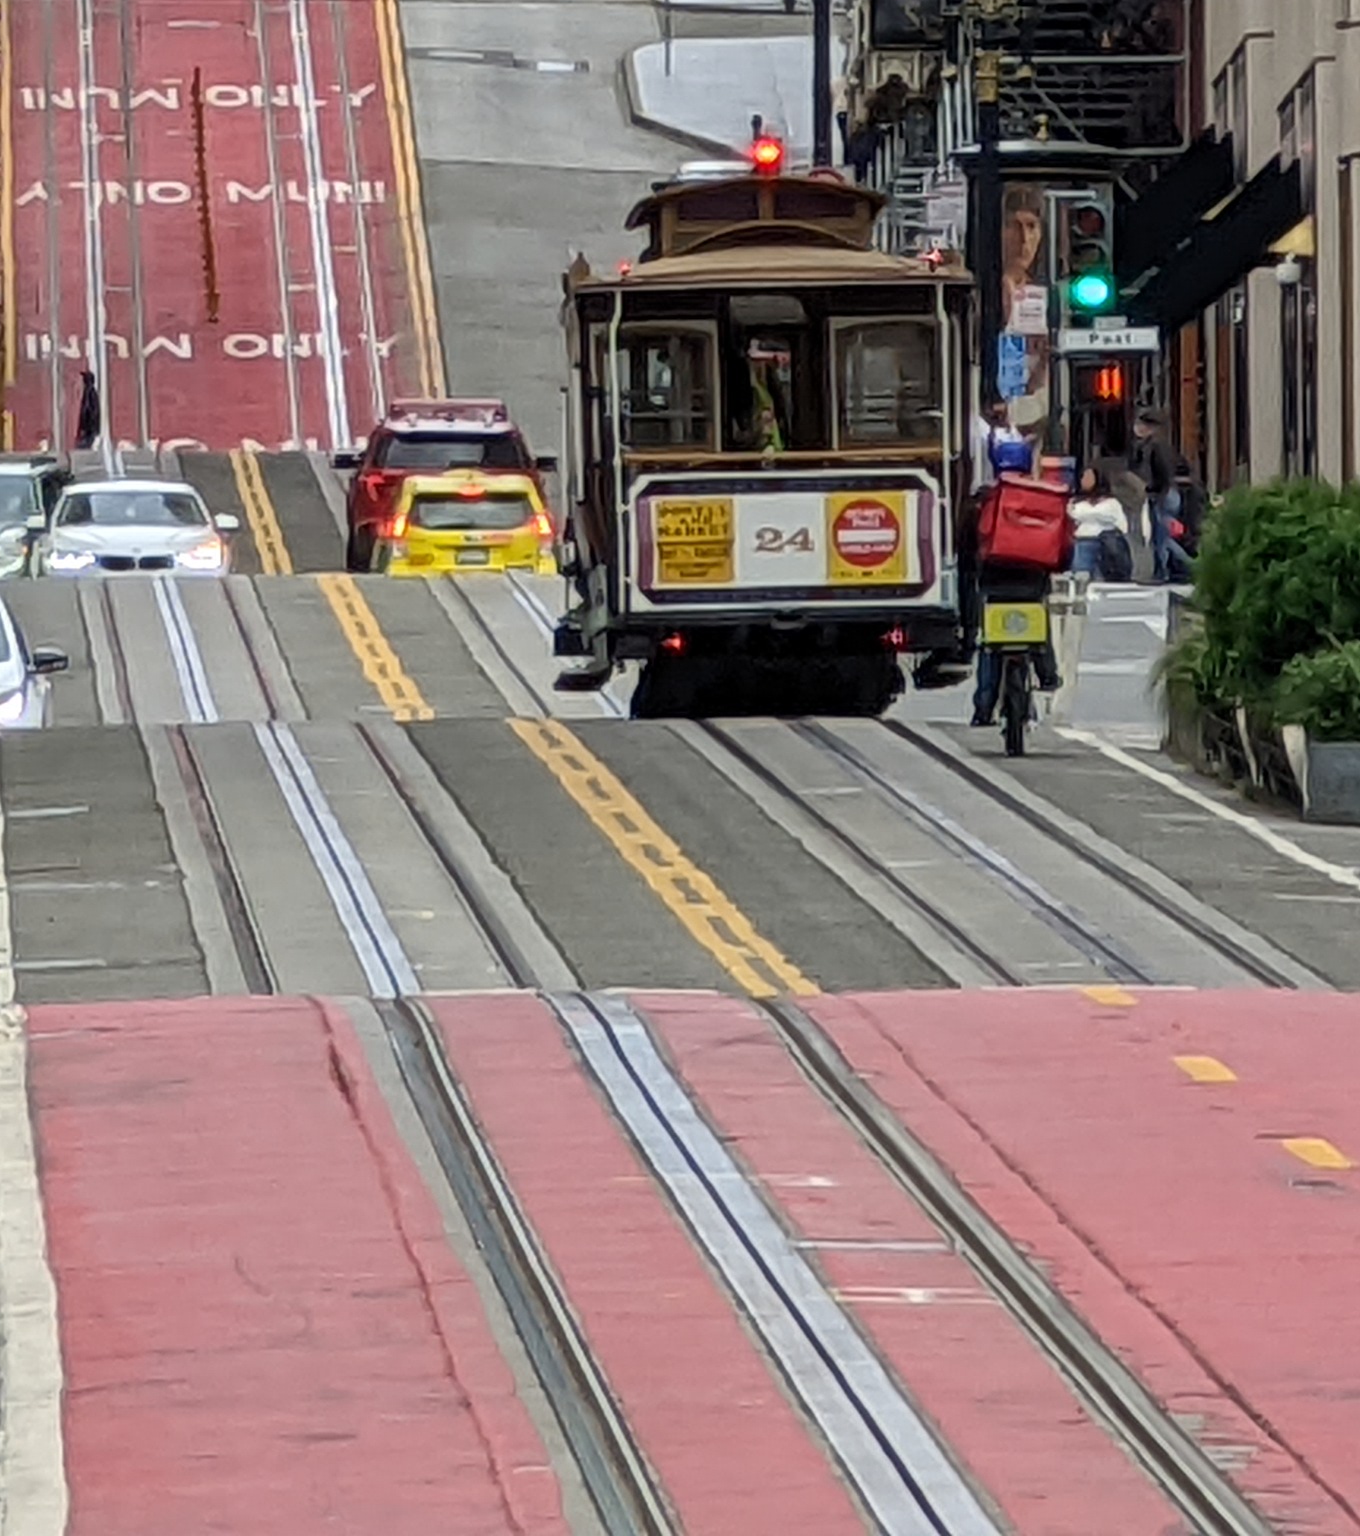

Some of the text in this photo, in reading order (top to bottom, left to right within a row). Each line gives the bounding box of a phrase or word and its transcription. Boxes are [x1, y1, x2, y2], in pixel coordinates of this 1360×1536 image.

[206, 83, 377, 108] ONLY
[226, 180, 386, 204] MUNI
[25, 332, 193, 360] MUNI
[222, 332, 403, 359] ONLY
[754, 526, 815, 553] 24
